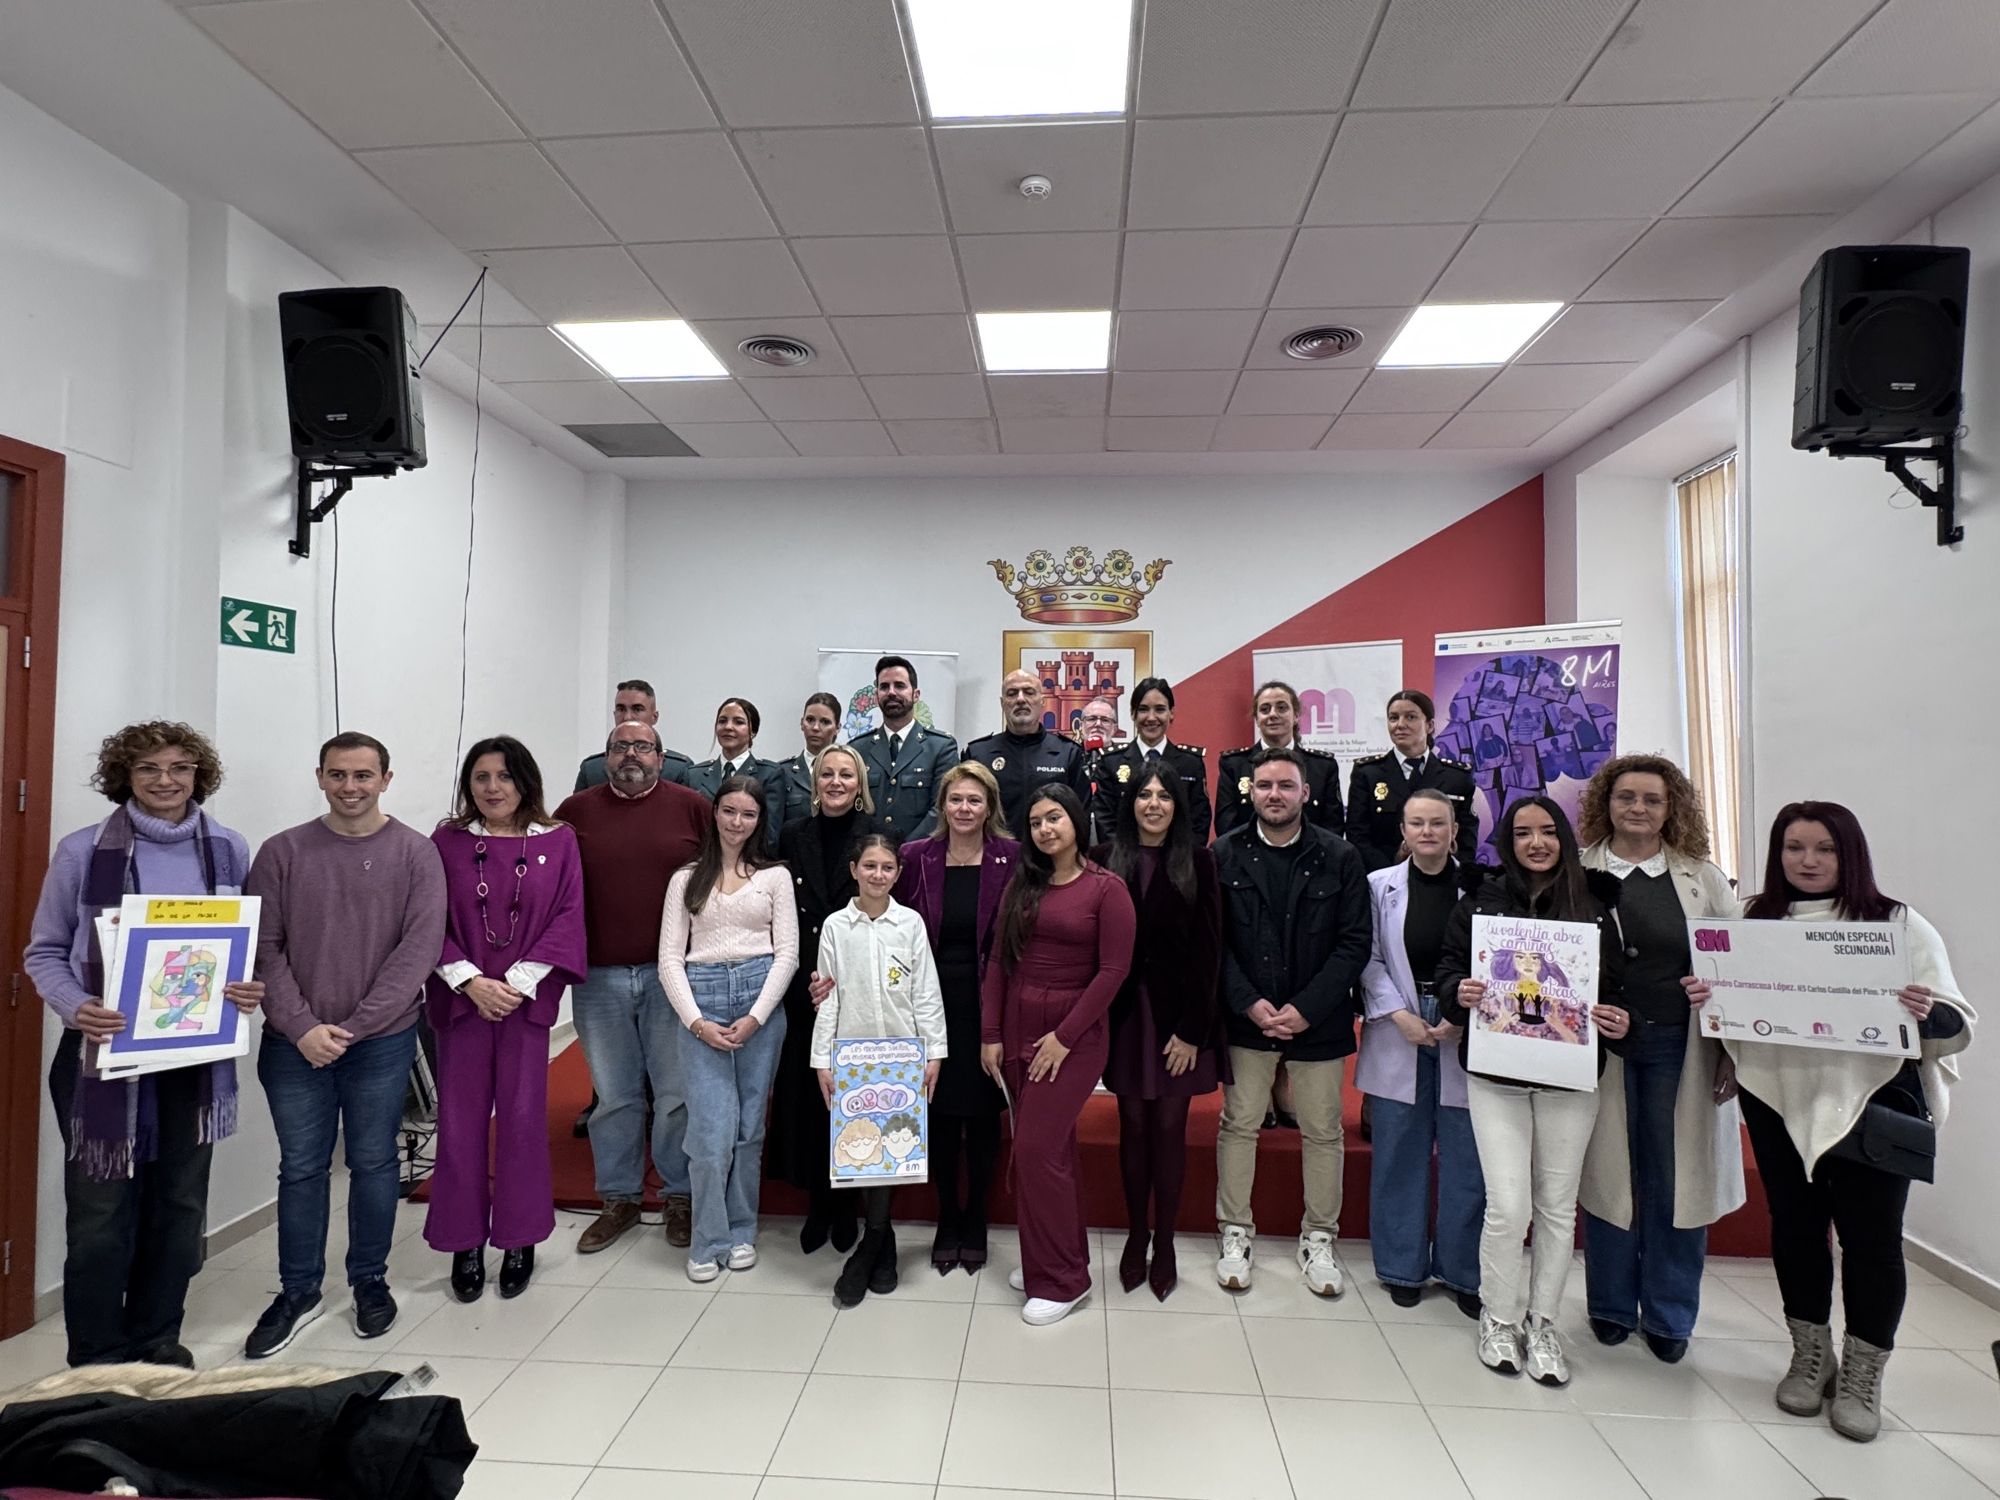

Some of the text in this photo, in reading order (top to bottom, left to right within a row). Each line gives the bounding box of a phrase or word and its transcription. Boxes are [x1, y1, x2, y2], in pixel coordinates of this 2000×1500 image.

[1805, 930, 1889, 943] MENCIÓN ESPECIAL
[1834, 944, 1891, 955] SECUNDARIA
